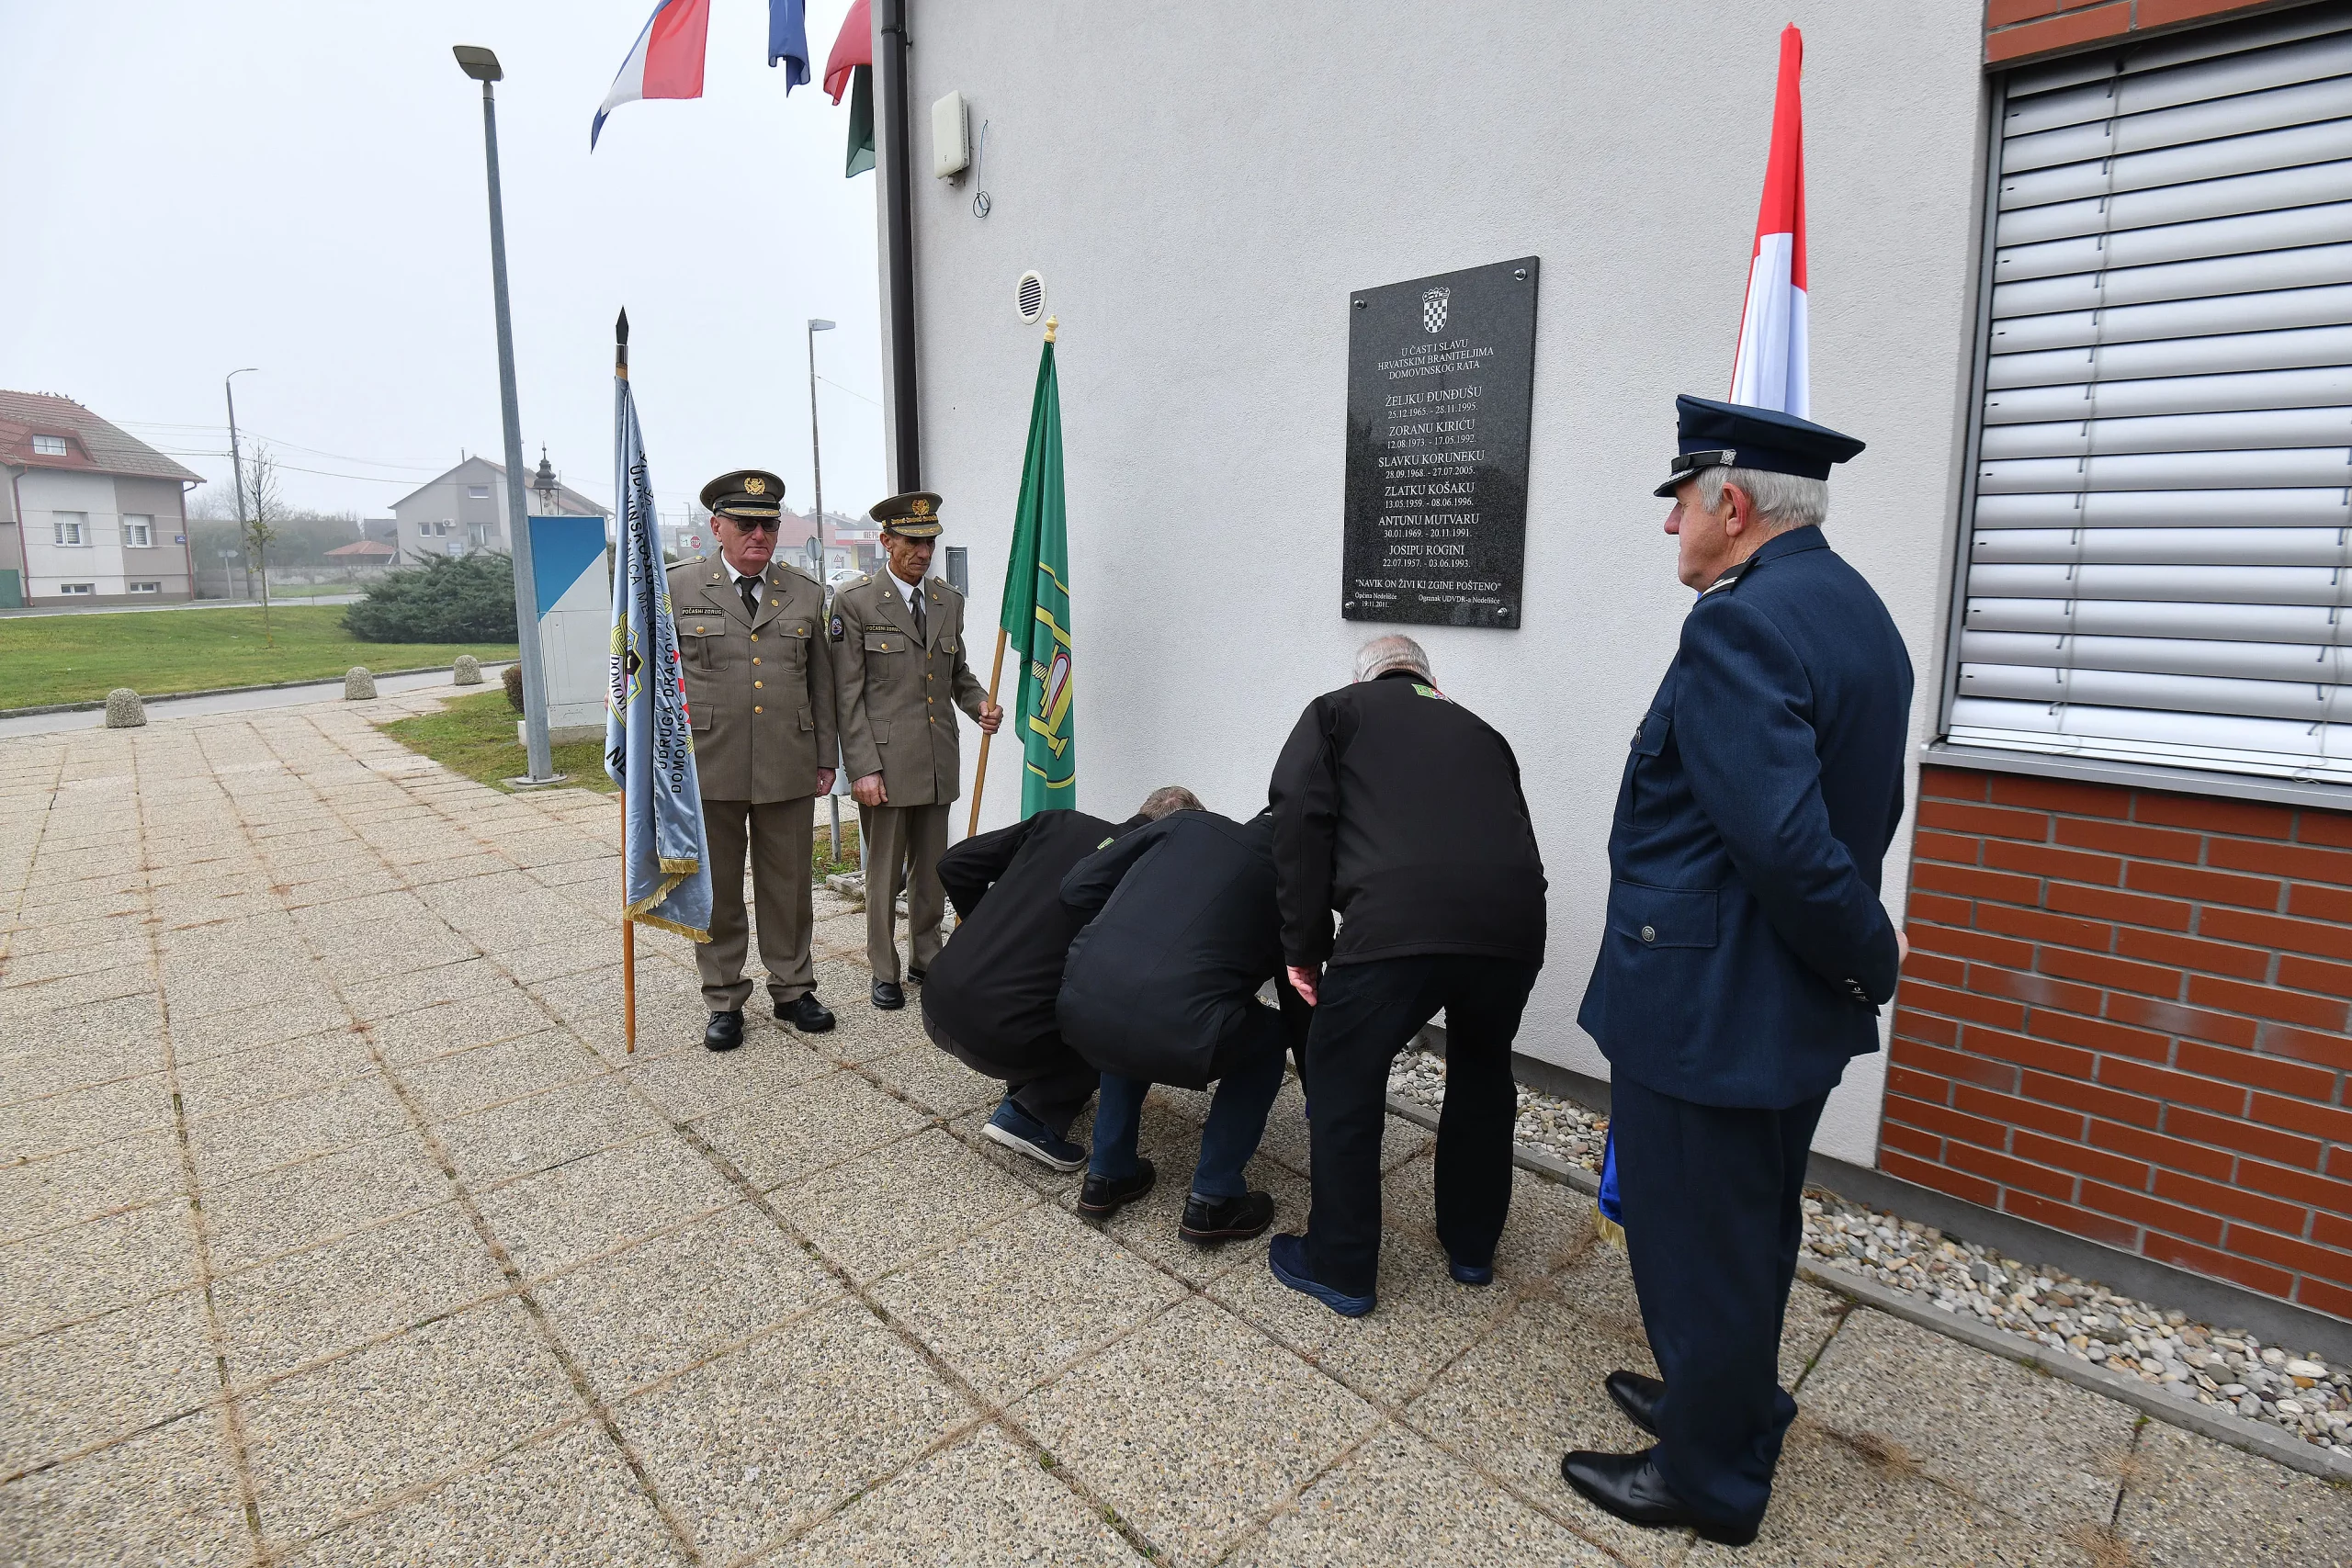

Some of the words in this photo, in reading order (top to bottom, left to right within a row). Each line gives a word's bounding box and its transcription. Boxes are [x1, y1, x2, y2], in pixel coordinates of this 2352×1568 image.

[1401, 348, 1408, 356] U
[1409, 344, 1432, 355] ČAST
[1439, 339, 1469, 351] SLAVU
[1377, 356, 1426, 370] HRVATSKIM
[1427, 346, 1494, 364] BRANITELJIMA
[1388, 364, 1454, 380] DOMOVINSKOG
[1456, 359, 1480, 372] RATA
[1385, 392, 1424, 407] ŽELJKU
[1426, 385, 1482, 402] ĐUNĐUŠU
[1387, 407, 1429, 419] 25.12.1965.
[1435, 401, 1478, 414] 28.11.1995.
[1388, 423, 1433, 437] ZORANU
[1436, 416, 1476, 433] KIRIĆU
[1387, 438, 1427, 449] 12.08.1973.
[1434, 434, 1476, 446] 17.05.1992.
[1378, 454, 1419, 468] SLAVKU
[1421, 449, 1485, 465] KORUNEKU
[1385, 469, 1426, 479] 28.09.1968.
[1432, 466, 1476, 477] 27.07.2005.
[1385, 485, 1426, 497] ZLATKU
[1428, 480, 1475, 495] KOŠAKU
[1385, 499, 1424, 509] 13.05.1959.
[1430, 497, 1474, 507] 08.06.1996.
[1378, 515, 1422, 526] ANTUNU
[1424, 513, 1480, 525] MUTVARU
[1384, 529, 1423, 538] 30.01.1969.
[1430, 528, 1472, 537] 20.11.1991.
[1389, 545, 1423, 556] JOSIPU
[1426, 545, 1464, 556] ROGINI
[1383, 558, 1422, 568] 22.07.1957.
[1429, 559, 1471, 568] 03.06.1993.
[1385, 580, 1396, 588] ON
[1398, 578, 1415, 589] ŽIVI
[1428, 581, 1454, 590] ZGINE
[1419, 594, 1442, 603] Ogranak
[659, 705, 674, 770] UDRUGA
